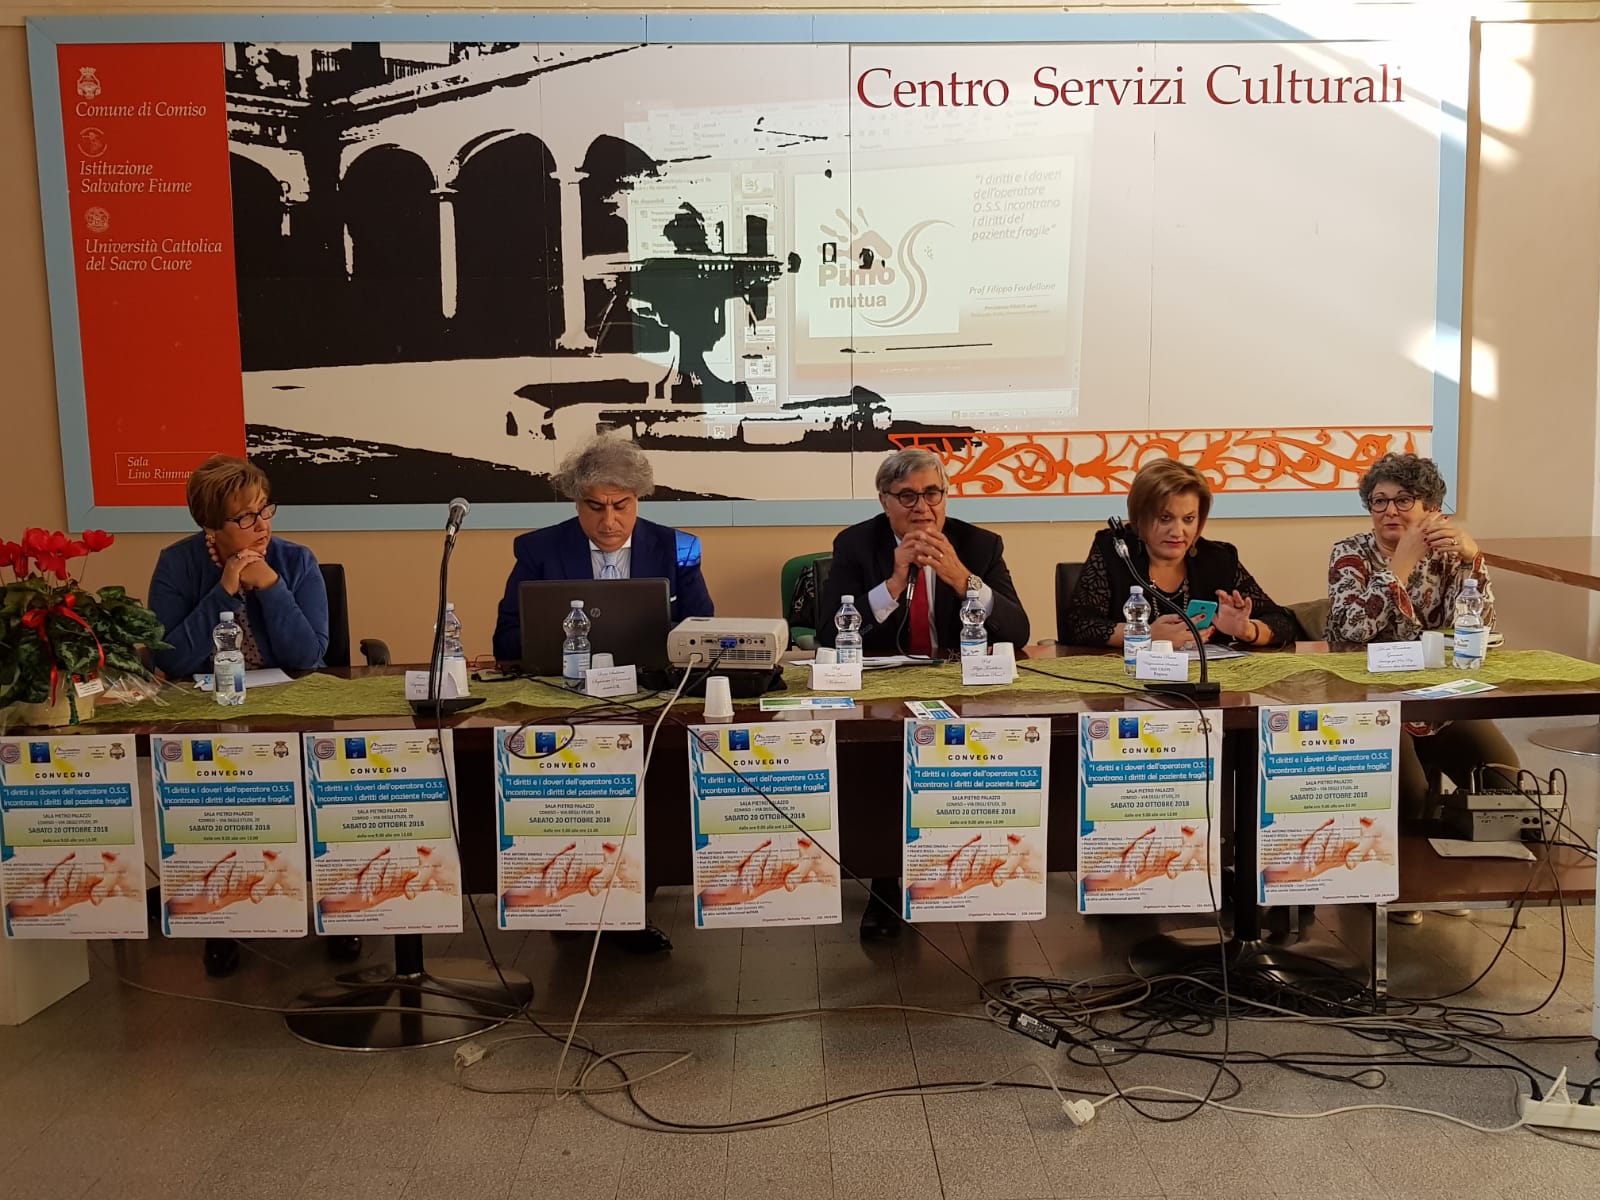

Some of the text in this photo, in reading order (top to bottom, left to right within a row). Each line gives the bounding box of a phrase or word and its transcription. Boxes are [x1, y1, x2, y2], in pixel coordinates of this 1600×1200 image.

[857, 63, 1405, 108] Centro Servizi Culturali
[76, 102, 207, 117] Comune di Comiso
[79, 160, 153, 175] Istituzione
[81, 178, 192, 193] Salvatore Fiume
[85, 239, 222, 253] Università Cattolica
[86, 256, 193, 271] del Sacro Cuore
[830, 293, 887, 308] mutua
[128, 456, 148, 467] Sala
[128, 469, 150, 479] Lino
[543, 778, 564, 786] doveri
[708, 776, 726, 784] diritti
[237, 796, 266, 804] paziente
[391, 793, 420, 801] paziente
